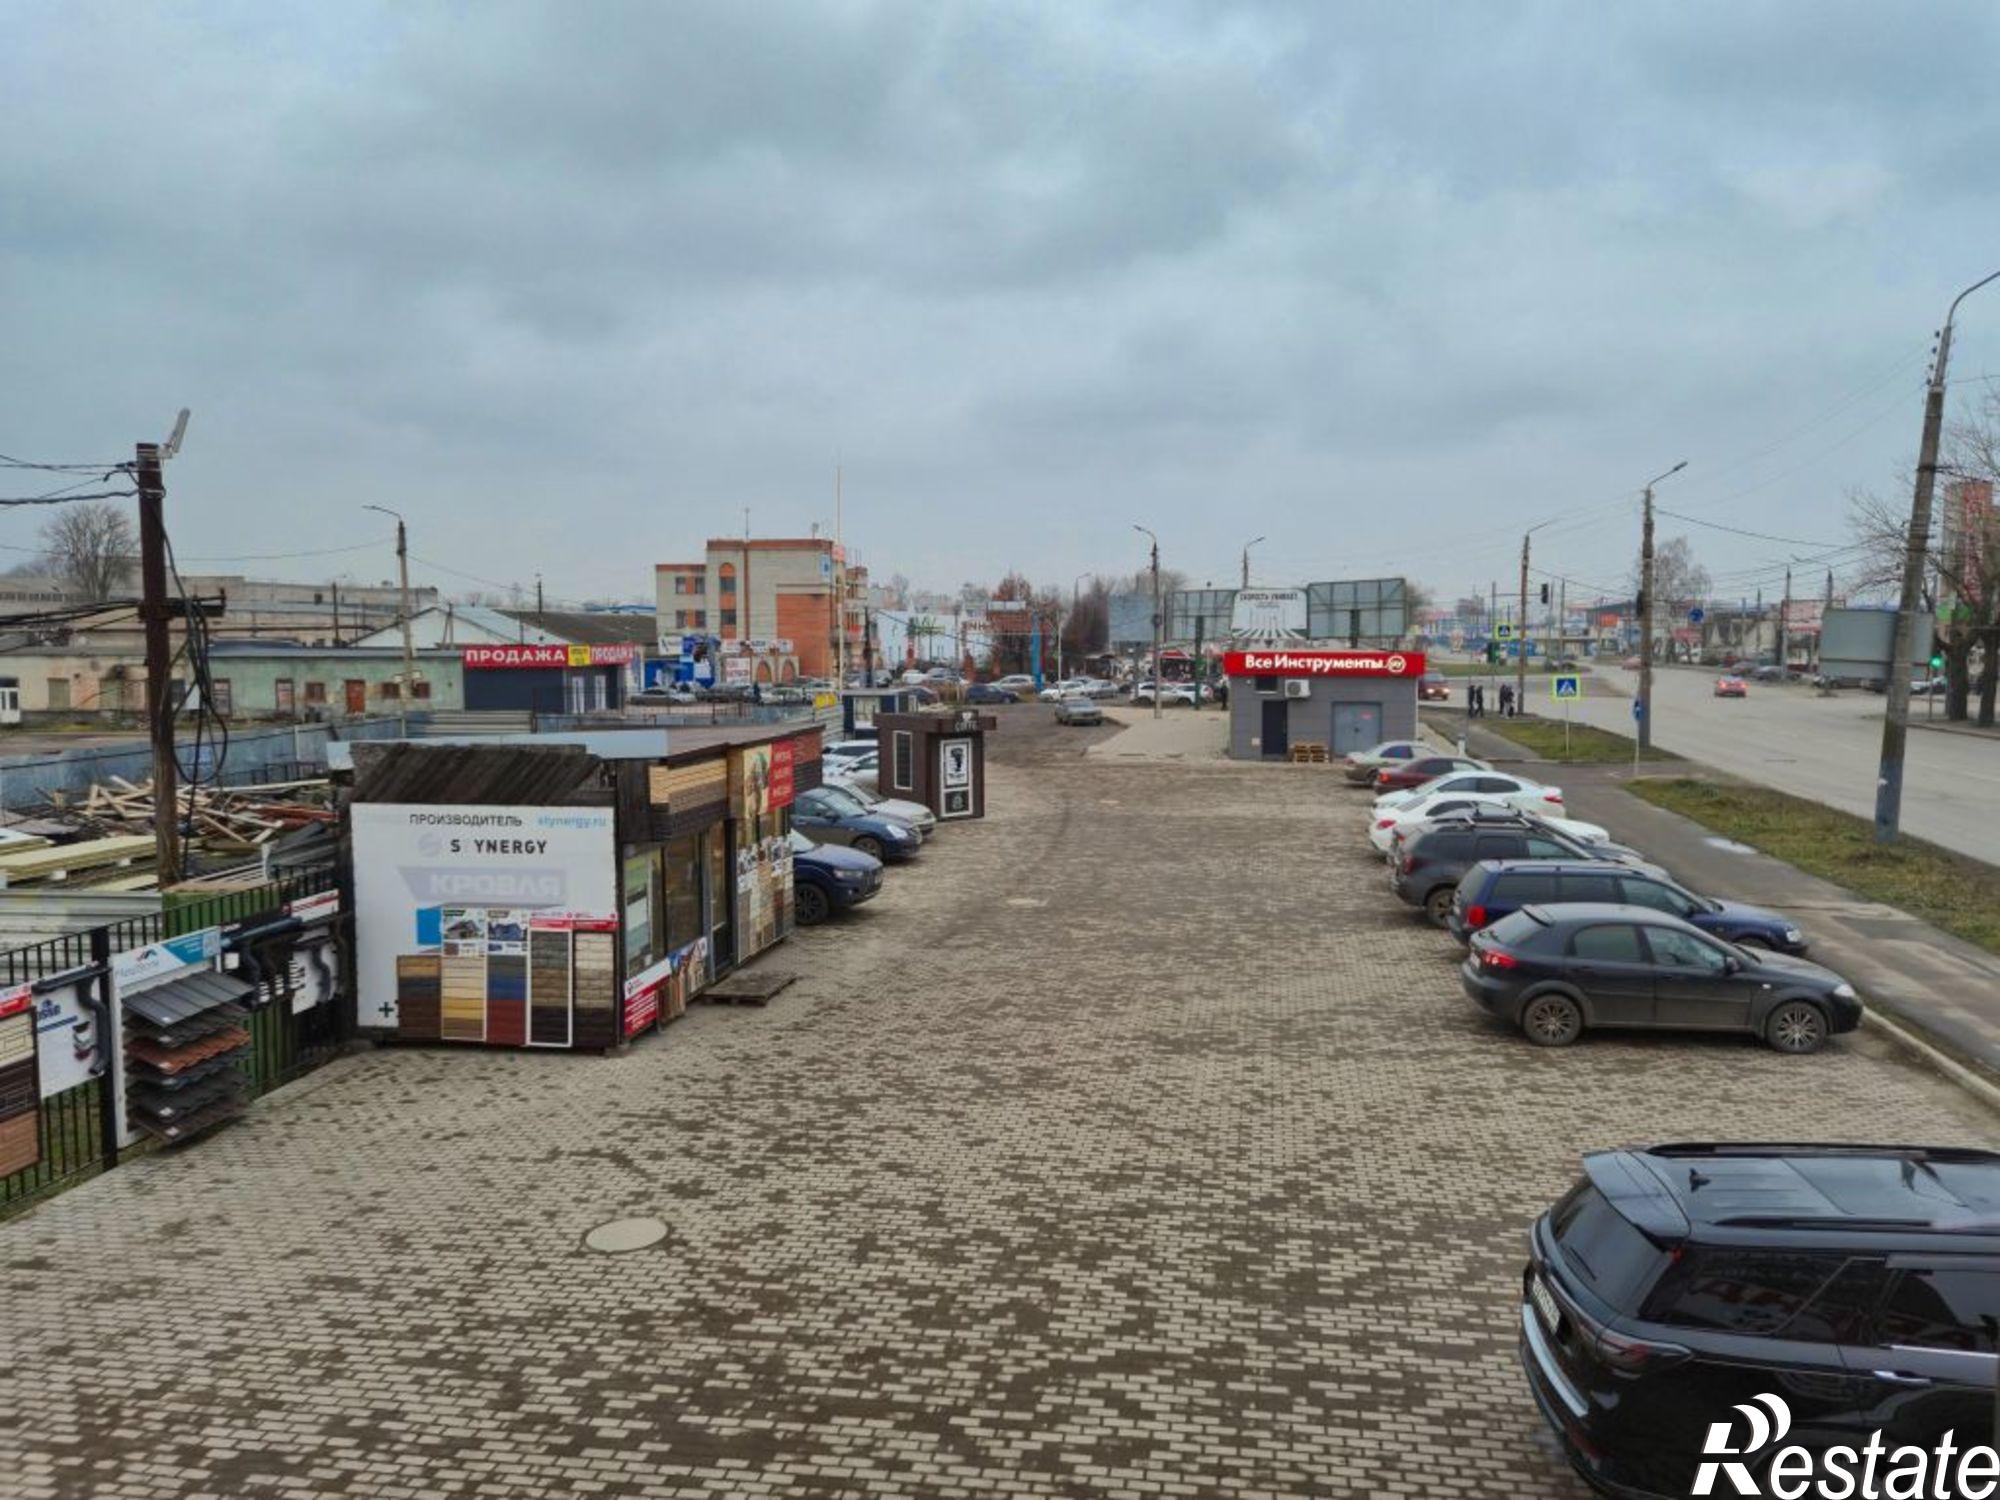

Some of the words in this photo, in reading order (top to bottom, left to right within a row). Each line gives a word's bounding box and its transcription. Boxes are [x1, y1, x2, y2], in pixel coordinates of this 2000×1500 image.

[466, 649, 566, 664] ПРОДАЖА
[410, 813, 523, 828] ПРОИЗВОДИТЕЛЬ
[429, 873, 560, 896] КРОВЛЯ
